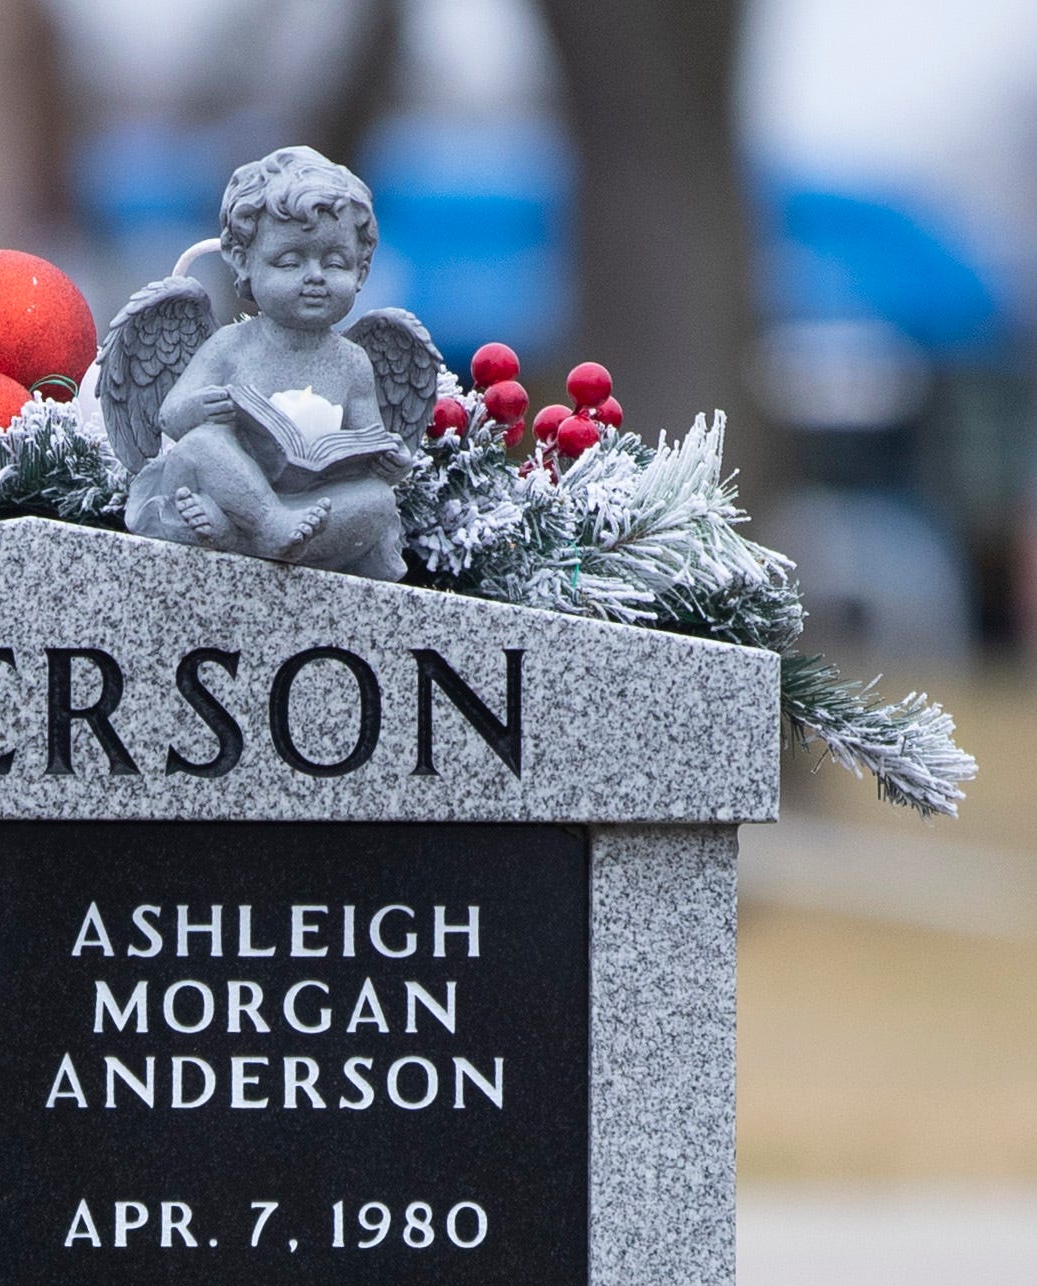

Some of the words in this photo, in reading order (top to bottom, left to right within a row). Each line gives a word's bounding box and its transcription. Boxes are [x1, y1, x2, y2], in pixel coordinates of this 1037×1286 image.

[71, 901, 481, 959] ASHLEIGH
[93, 976, 457, 1034] MORGAN
[45, 1052, 504, 1110] ANDERSON
[63, 1198, 219, 1248] APR.
[250, 1201, 299, 1253] 7,
[331, 1200, 488, 1249] 1980
